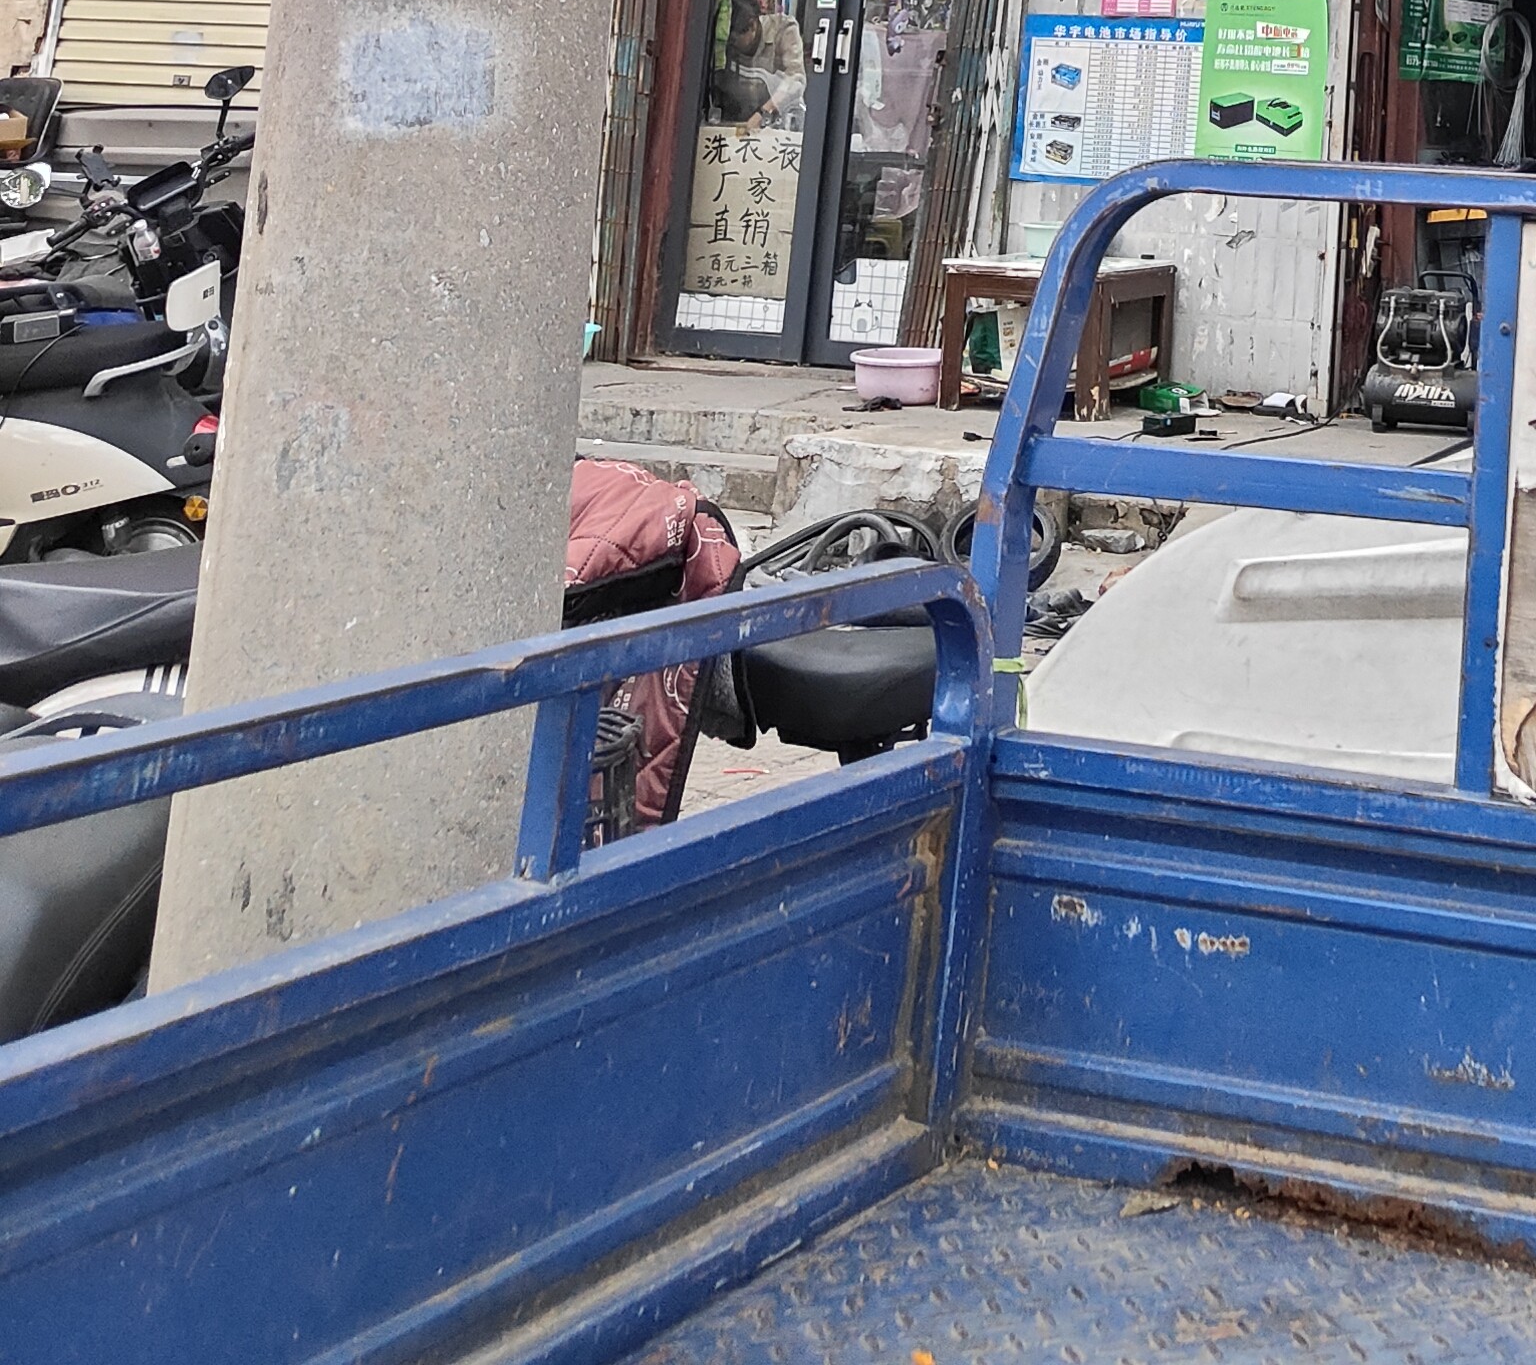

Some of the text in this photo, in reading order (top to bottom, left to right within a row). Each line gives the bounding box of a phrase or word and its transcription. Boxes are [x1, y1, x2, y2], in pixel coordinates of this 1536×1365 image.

[1053, 24, 1188, 42] 华宇电池市场指导价
[702, 133, 803, 173] 洗衣液
[713, 171, 776, 204] 厂家
[707, 204, 770, 248] 直销
[695, 250, 778, 276] 一百元三箱
[665, 514, 678, 548] BEST
